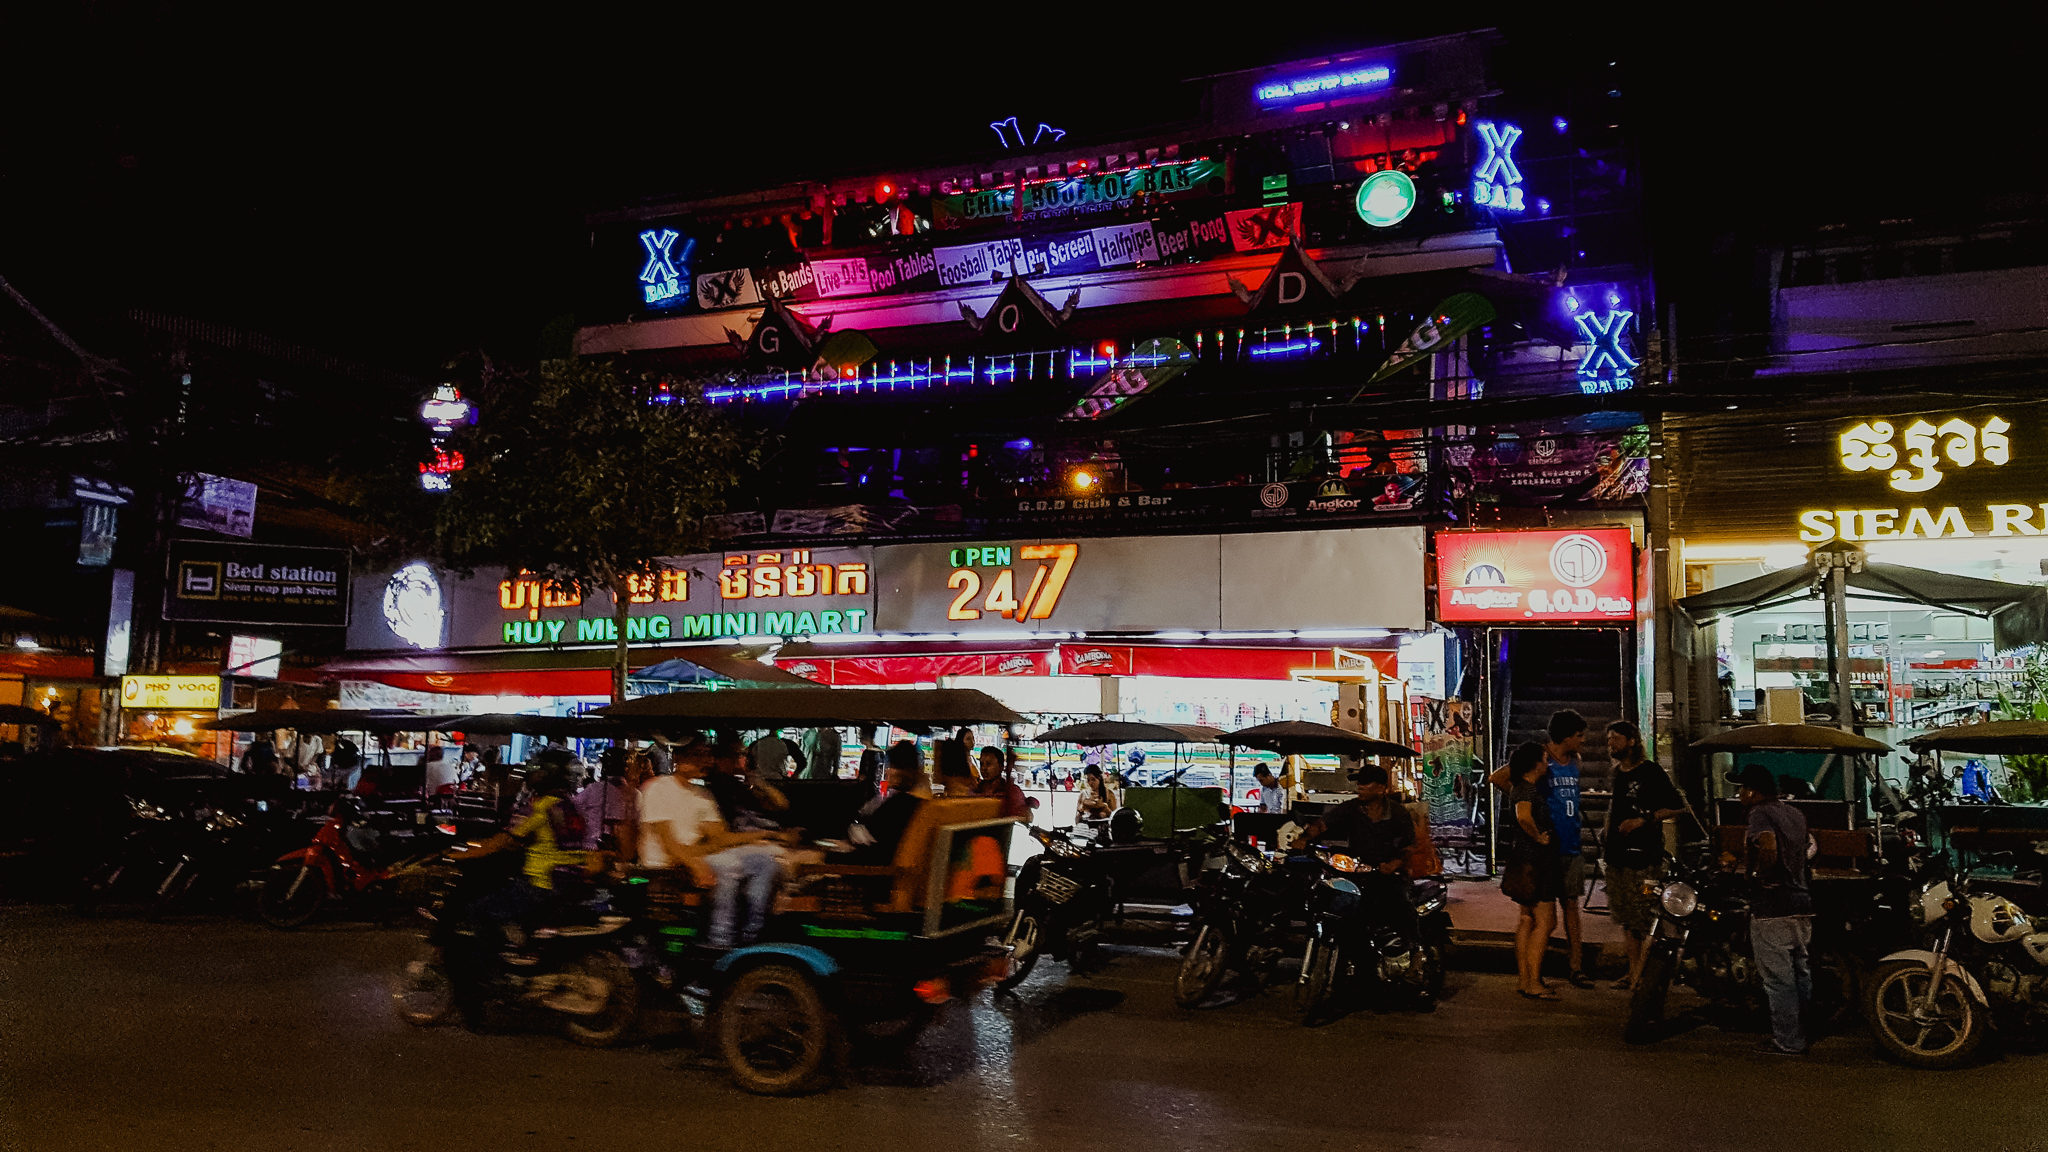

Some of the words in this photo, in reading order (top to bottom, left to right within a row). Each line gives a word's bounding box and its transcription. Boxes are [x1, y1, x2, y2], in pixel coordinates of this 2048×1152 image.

[1476, 123, 1522, 185] X
[1143, 166, 1193, 194] BAR
[1474, 181, 1526, 211] BAR
[1050, 234, 1094, 264] Screen
[1099, 226, 1152, 265] Halfpipe
[1157, 230, 1189, 256] Beer
[1190, 217, 1227, 247] Pong
[641, 229, 678, 283] X
[940, 248, 989, 285] Foosball
[988, 236, 1022, 268] Table
[755, 279, 779, 300] Lie
[778, 266, 813, 293] Bands
[816, 271, 841, 297] Live
[871, 269, 895, 291] Pool
[896, 252, 935, 281] Tables
[646, 279, 680, 302] BAR
[1278, 272, 1306, 303] D
[1000, 304, 1019, 333] O
[759, 326, 780, 354] G
[1574, 310, 1639, 377] X
[1073, 498, 1111, 510] Club
[1118, 497, 1131, 507] &
[1138, 495, 1172, 506] Bar
[1306, 498, 1362, 512] Angkor
[1799, 506, 1975, 542] SIEM
[1988, 503, 2048, 538] R
[226, 561, 264, 580] Bed
[270, 565, 338, 583] station
[950, 546, 1012, 568] OPEN
[254, 584, 279, 595] reap
[282, 585, 303, 596] pub
[306, 586, 338, 597] street
[947, 543, 1078, 623] 24/7
[1450, 589, 1523, 609] Angkor
[1528, 589, 1597, 612] G.O.D
[1597, 597, 1632, 611] Club
[503, 620, 565, 644] HUY
[683, 612, 757, 638] MINI
[765, 608, 867, 635] MART
[1566, 800, 1575, 817] 0
